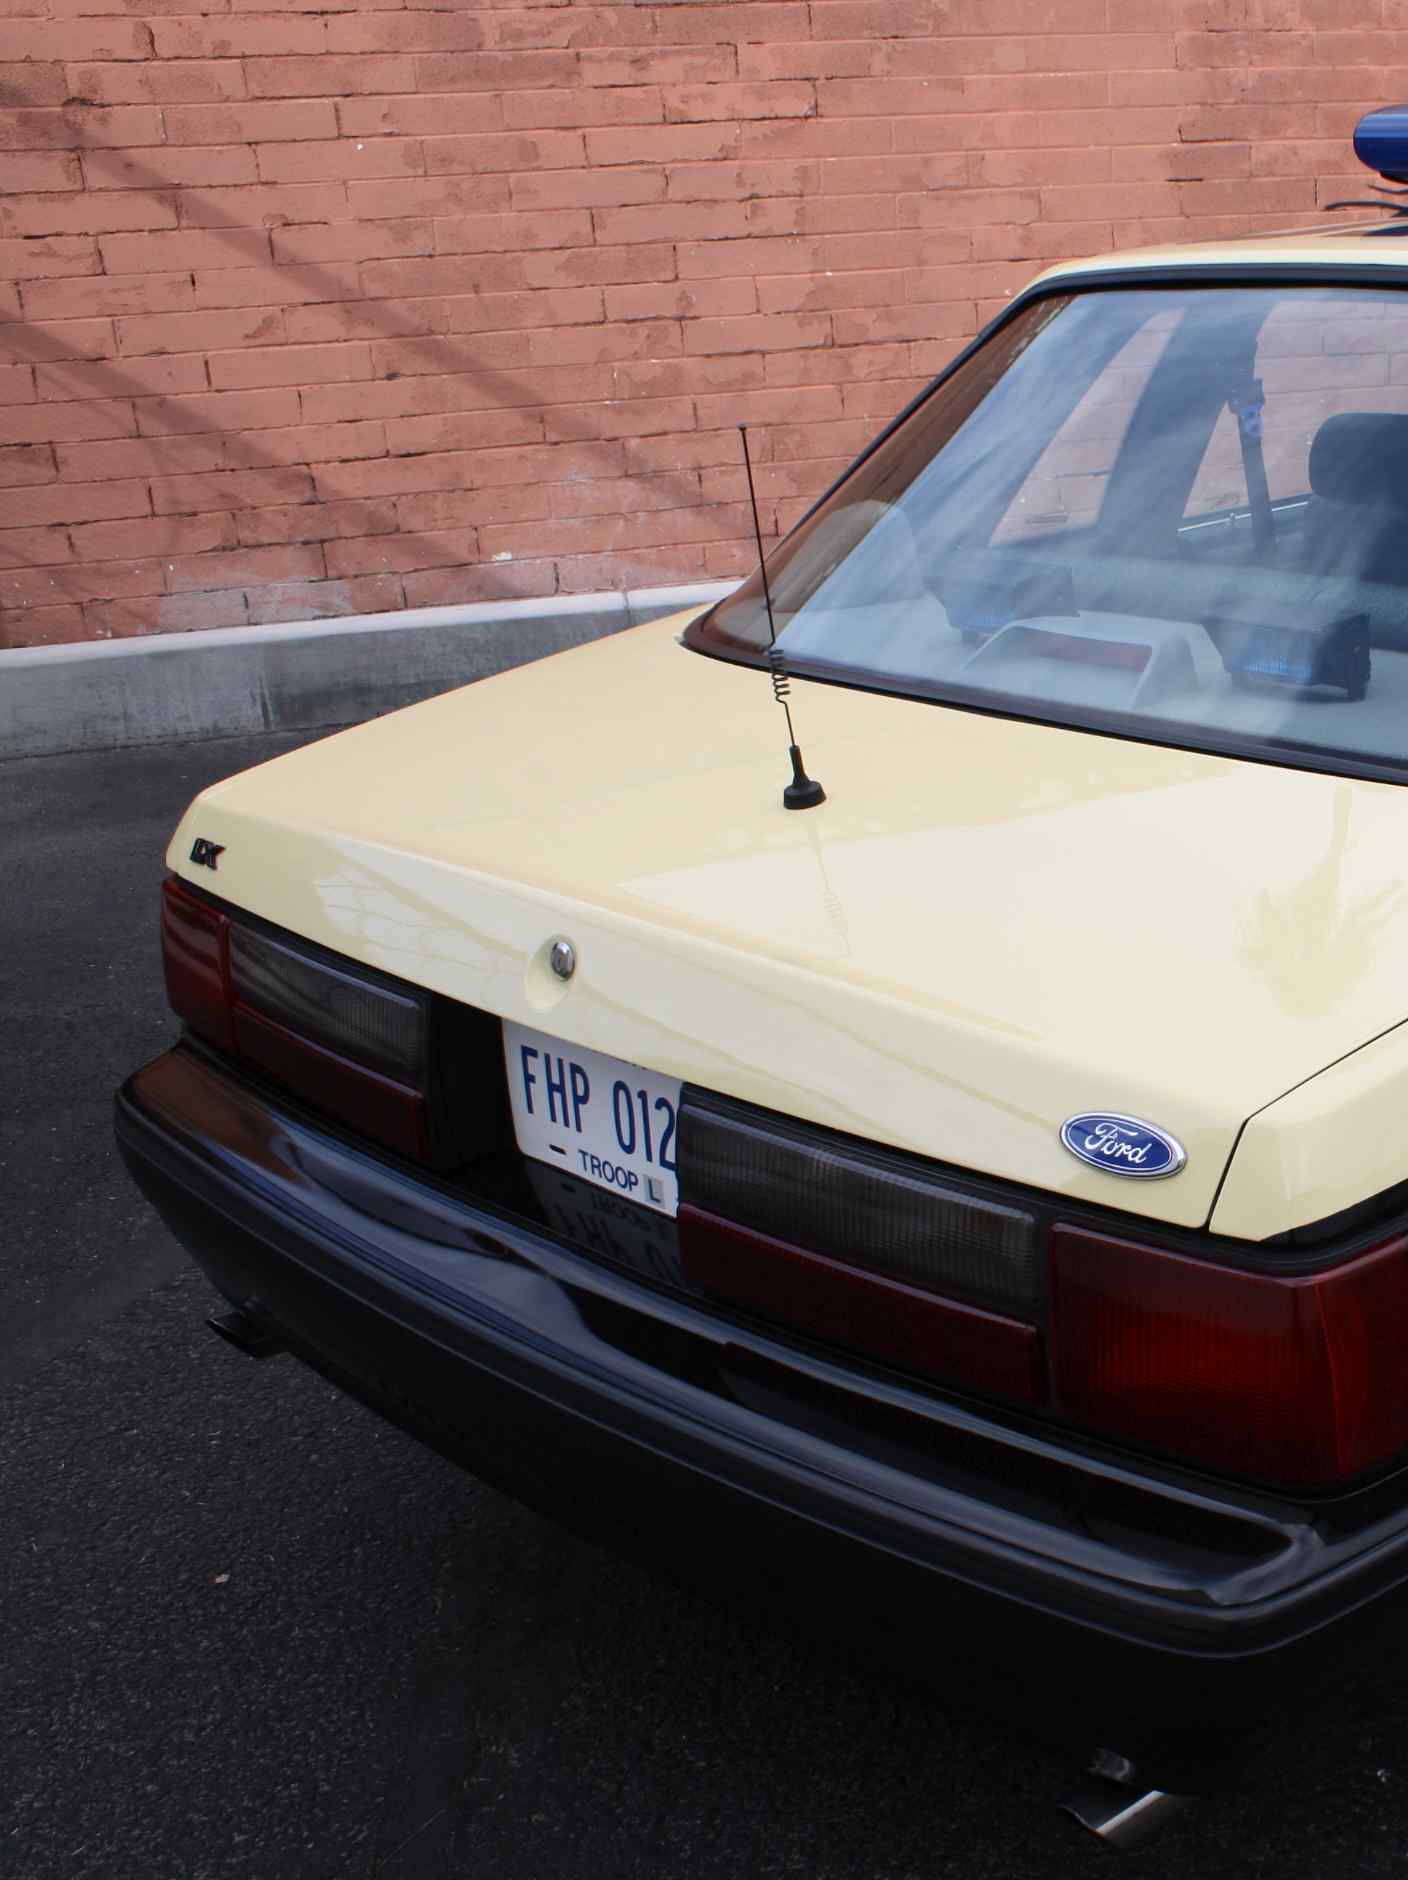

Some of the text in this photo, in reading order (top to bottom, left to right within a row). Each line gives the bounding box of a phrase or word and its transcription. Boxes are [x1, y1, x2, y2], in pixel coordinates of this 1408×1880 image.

[190, 837, 226, 871] LX
[520, 1044, 678, 1172] FHP 012
[1084, 1122, 1152, 1163] Ford
[578, 1149, 662, 1202] TROOP L
